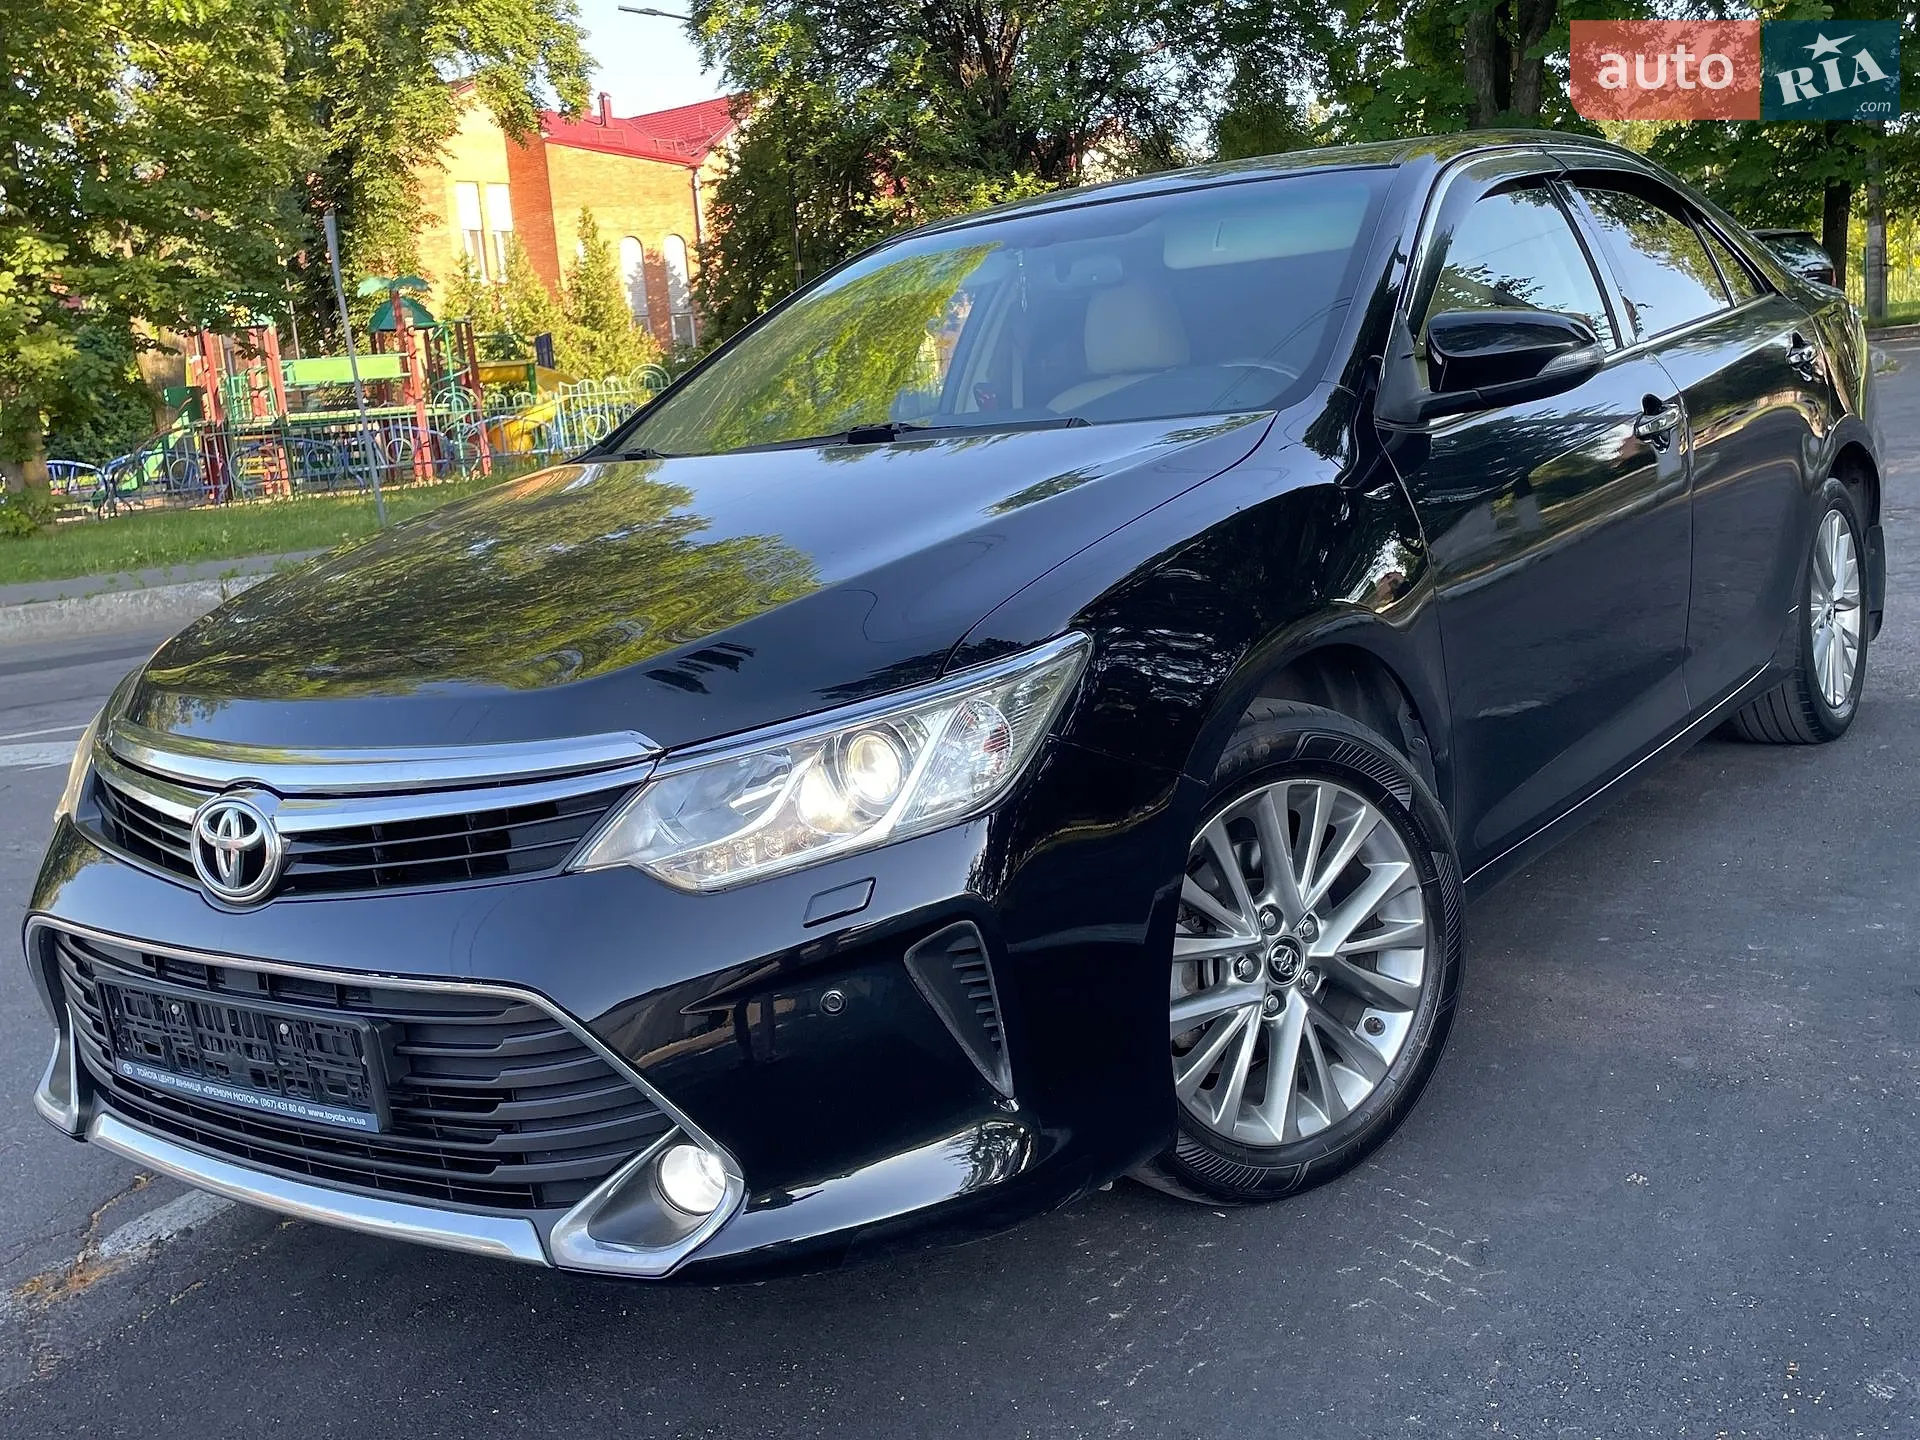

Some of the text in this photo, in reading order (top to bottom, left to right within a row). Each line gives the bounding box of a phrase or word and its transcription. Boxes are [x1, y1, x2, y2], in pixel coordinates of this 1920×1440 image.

[260, 1097, 277, 1110] (067)
[277, 1101, 288, 1111] 431
[297, 1105, 306, 1115] 40
[307, 1109, 366, 1126] www.toyota.vn.ua
